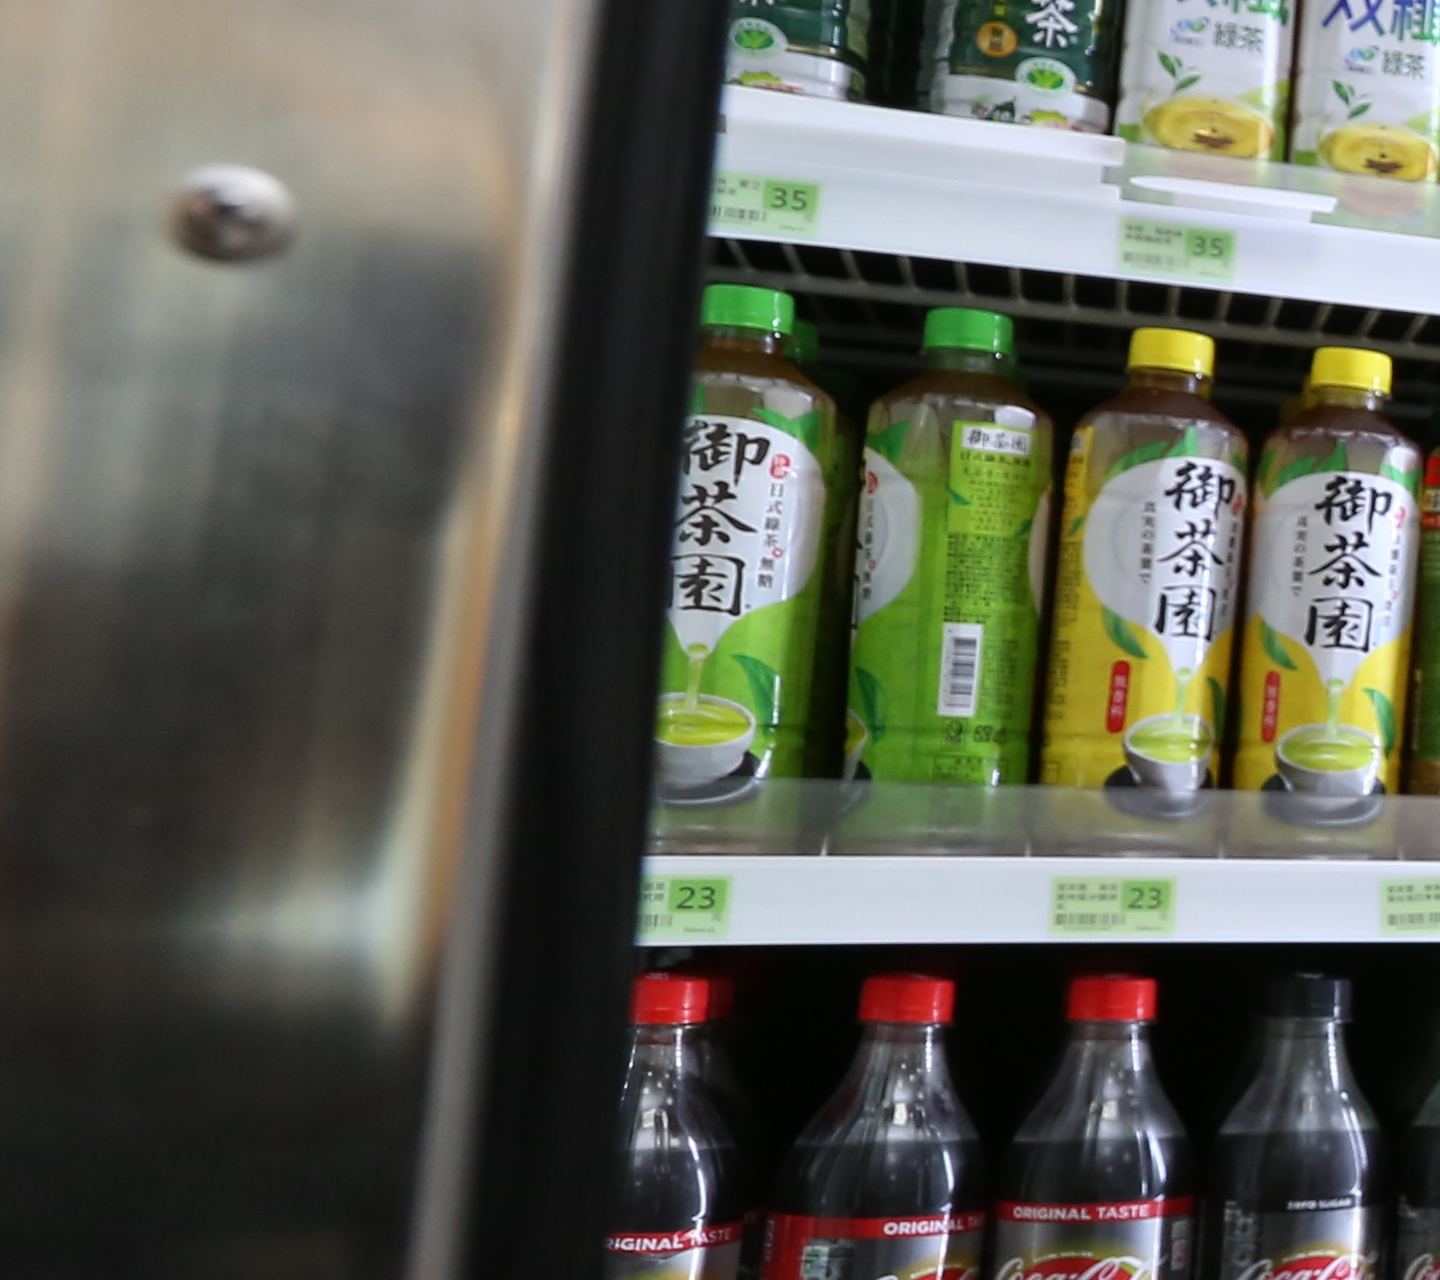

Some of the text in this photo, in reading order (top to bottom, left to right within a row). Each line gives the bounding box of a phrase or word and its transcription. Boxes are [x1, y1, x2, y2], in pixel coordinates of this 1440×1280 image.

[1212, 20, 1264, 55] 綠茶
[1381, 49, 1426, 81] 綠茶
[769, 186, 809, 211] 35
[1192, 237, 1225, 258] 35
[672, 421, 770, 616] 御茶園
[1154, 461, 1236, 642] 御茶園
[1303, 475, 1393, 653] 御茶園
[676, 885, 716, 910] 23
[1128, 886, 1164, 909] 23
[1013, 1203, 1150, 1220] ORIGINAL TASTE
[884, 1219, 963, 1235] ORIGINAL
[604, 1234, 681, 1253] RIGINAL
